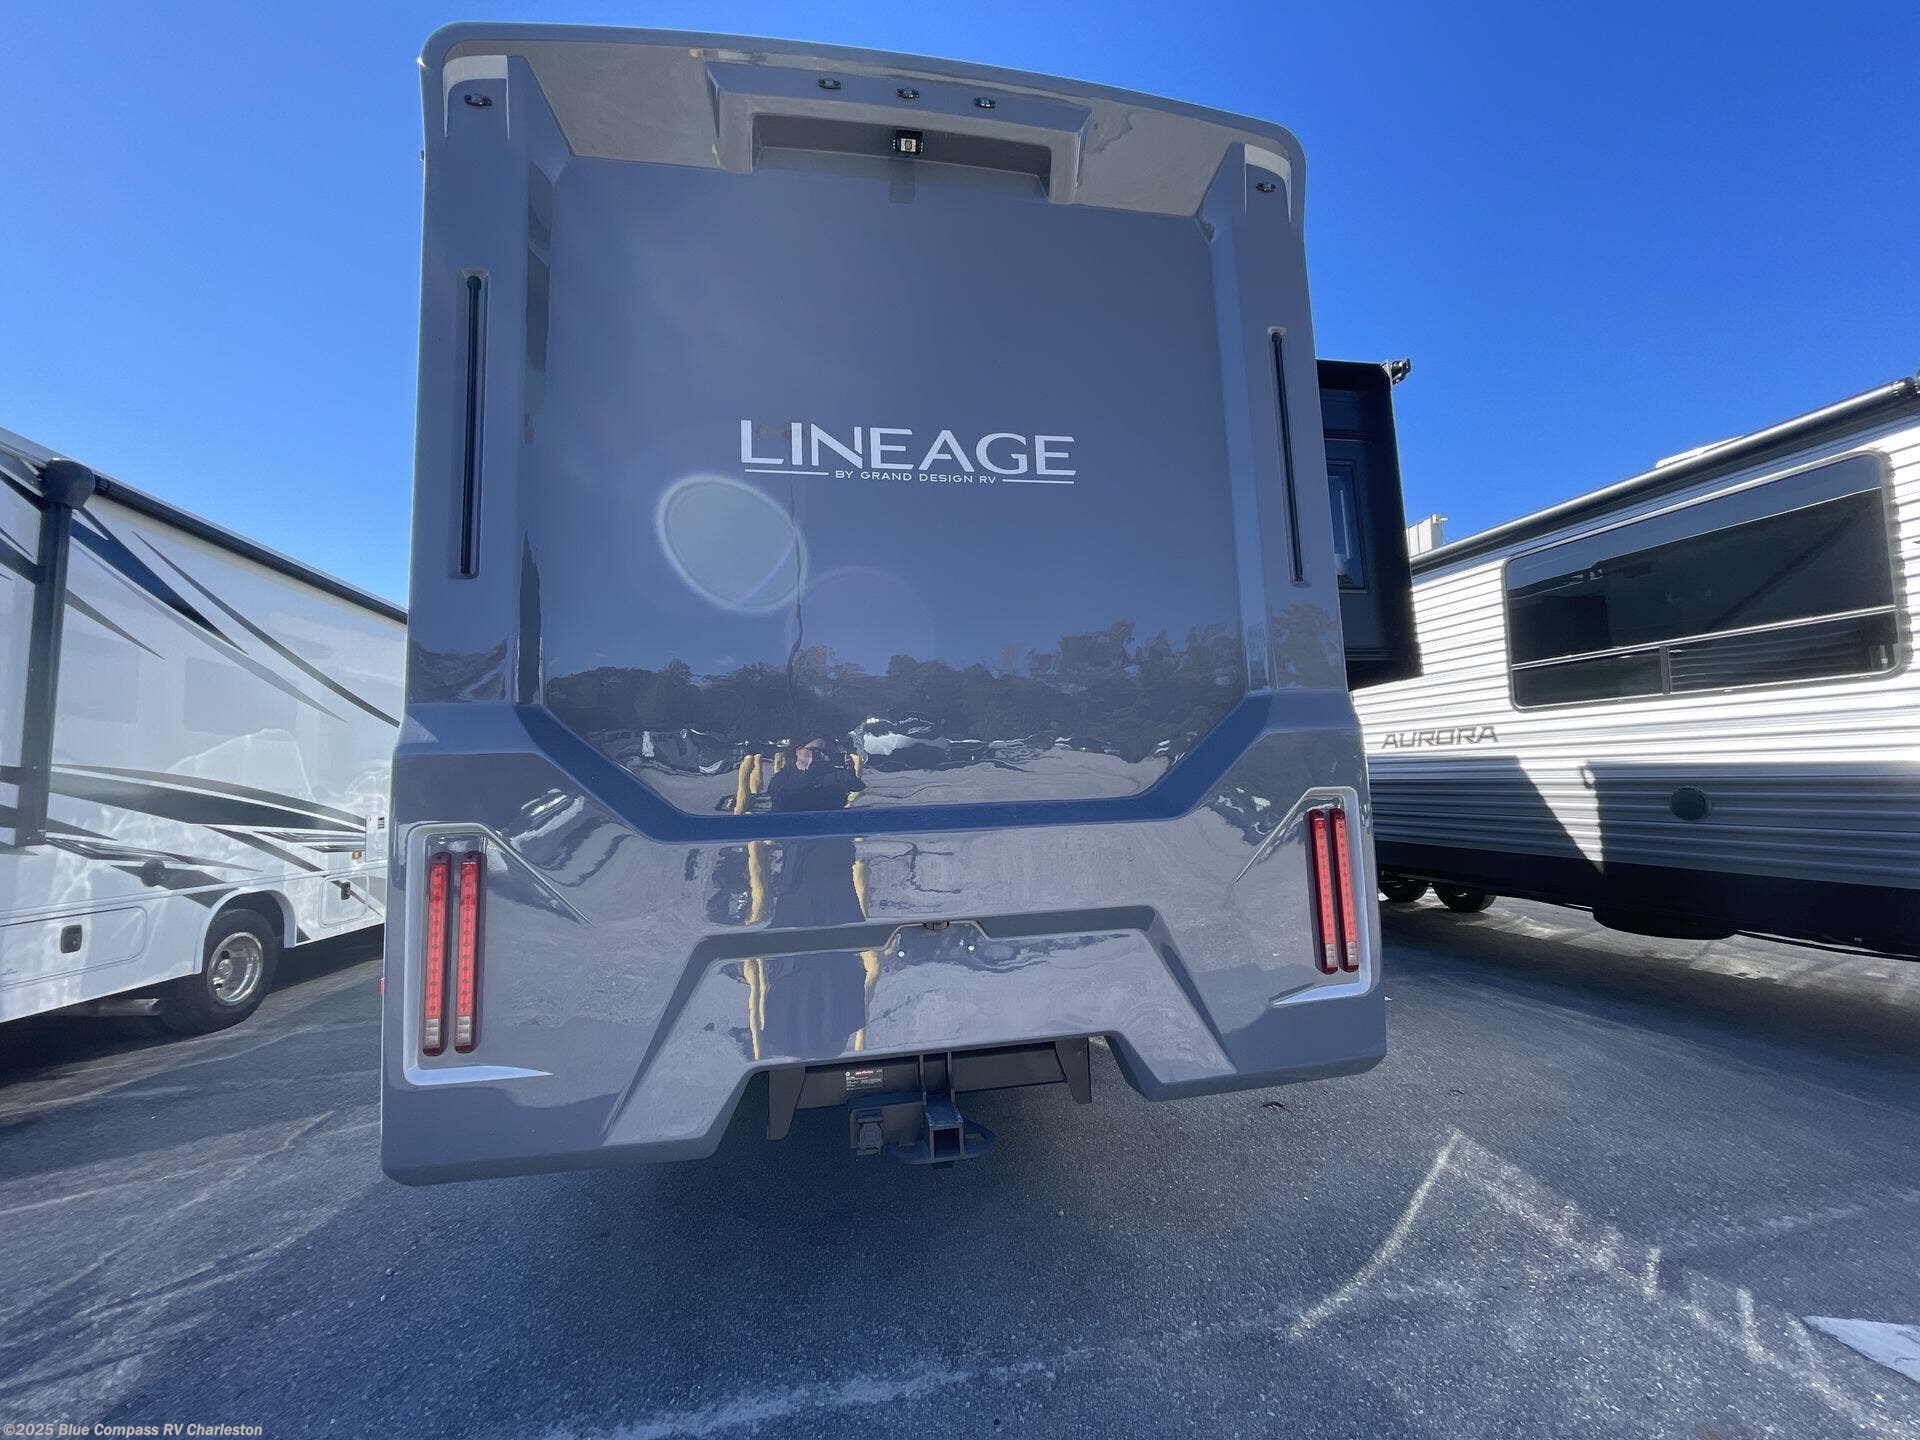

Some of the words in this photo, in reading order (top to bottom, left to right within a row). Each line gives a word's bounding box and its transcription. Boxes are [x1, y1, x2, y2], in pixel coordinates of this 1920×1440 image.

[741, 420, 1077, 476] LINEAGE
[835, 470, 853, 480] BY
[860, 471, 912, 481] GRAND
[919, 473, 973, 484] DESIGN
[979, 475, 997, 484] RV
[1381, 726, 1499, 749] AURORA
